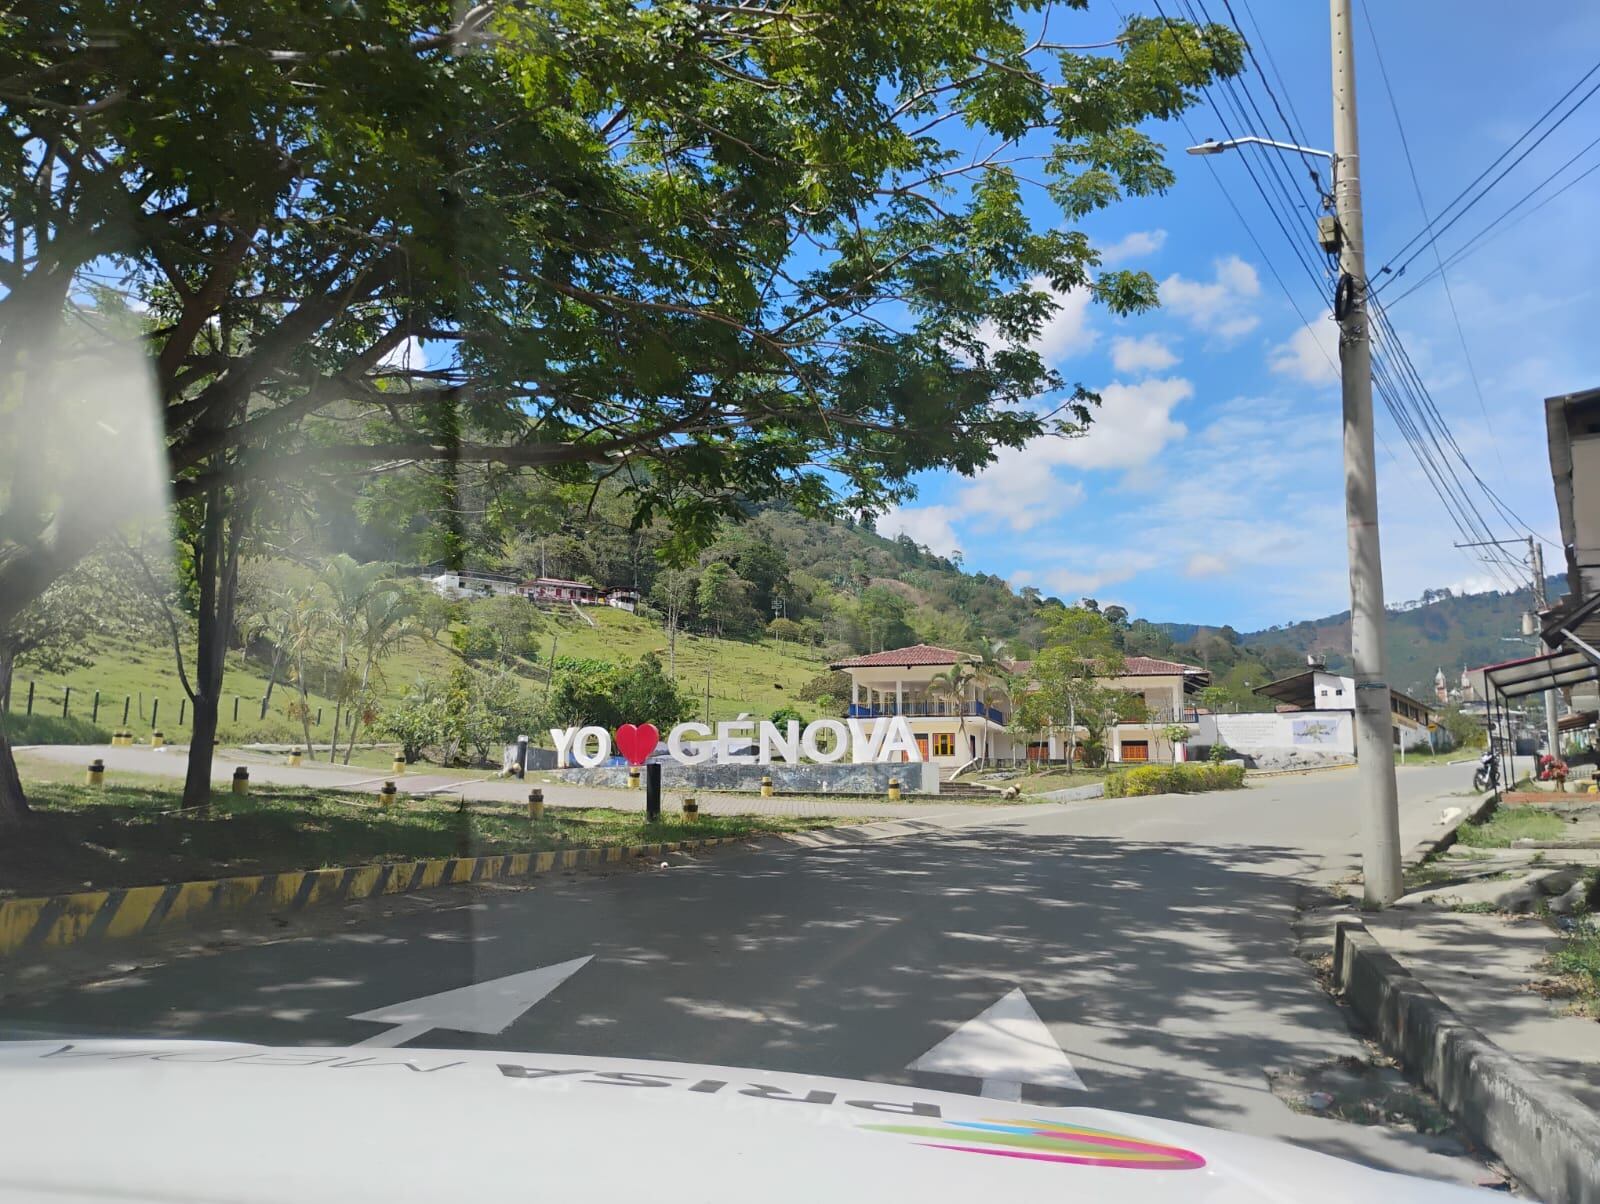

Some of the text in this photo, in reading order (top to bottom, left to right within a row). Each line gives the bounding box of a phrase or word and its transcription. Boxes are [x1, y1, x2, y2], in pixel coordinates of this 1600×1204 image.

[551, 714, 924, 767] YO GÉNOVA
[496, 1064, 941, 1118] PRISA
